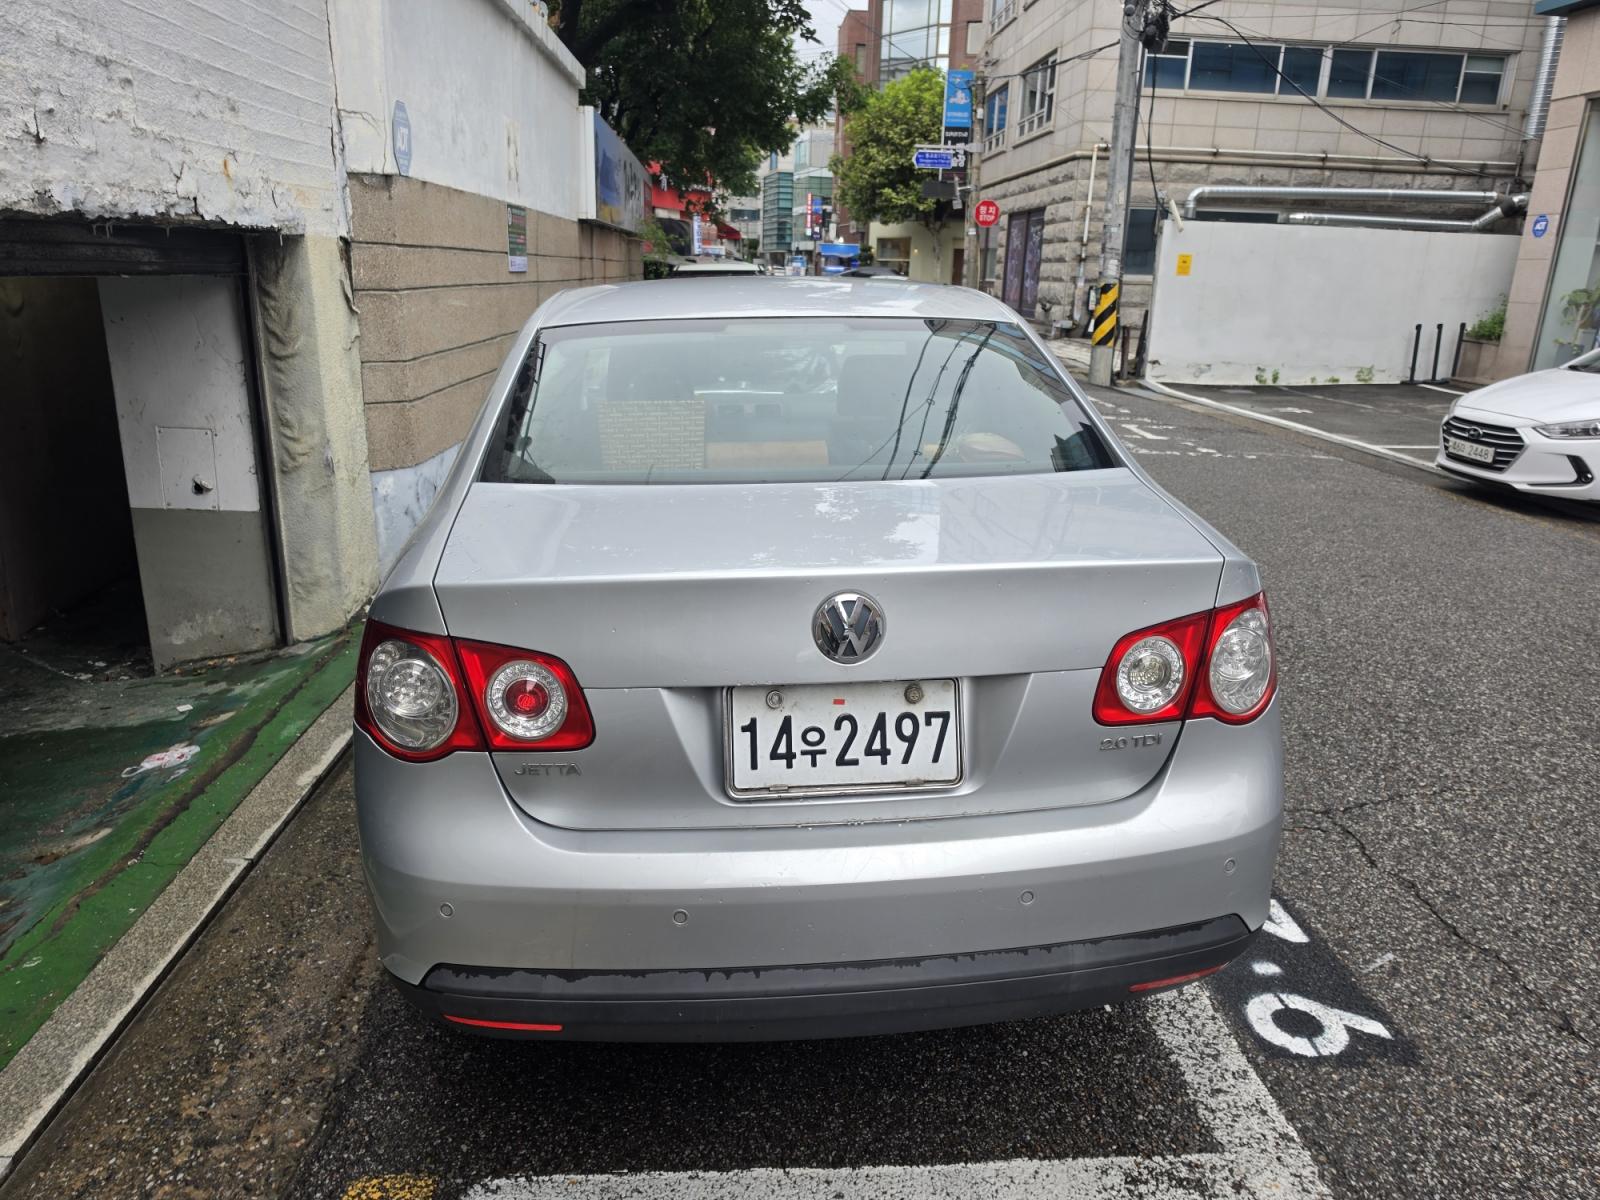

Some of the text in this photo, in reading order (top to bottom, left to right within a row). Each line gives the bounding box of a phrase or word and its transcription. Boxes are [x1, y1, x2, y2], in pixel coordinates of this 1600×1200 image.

[740, 710, 951, 772] 14우2497
[1131, 732, 1163, 748] TDI
[514, 762, 582, 776] JETTA
